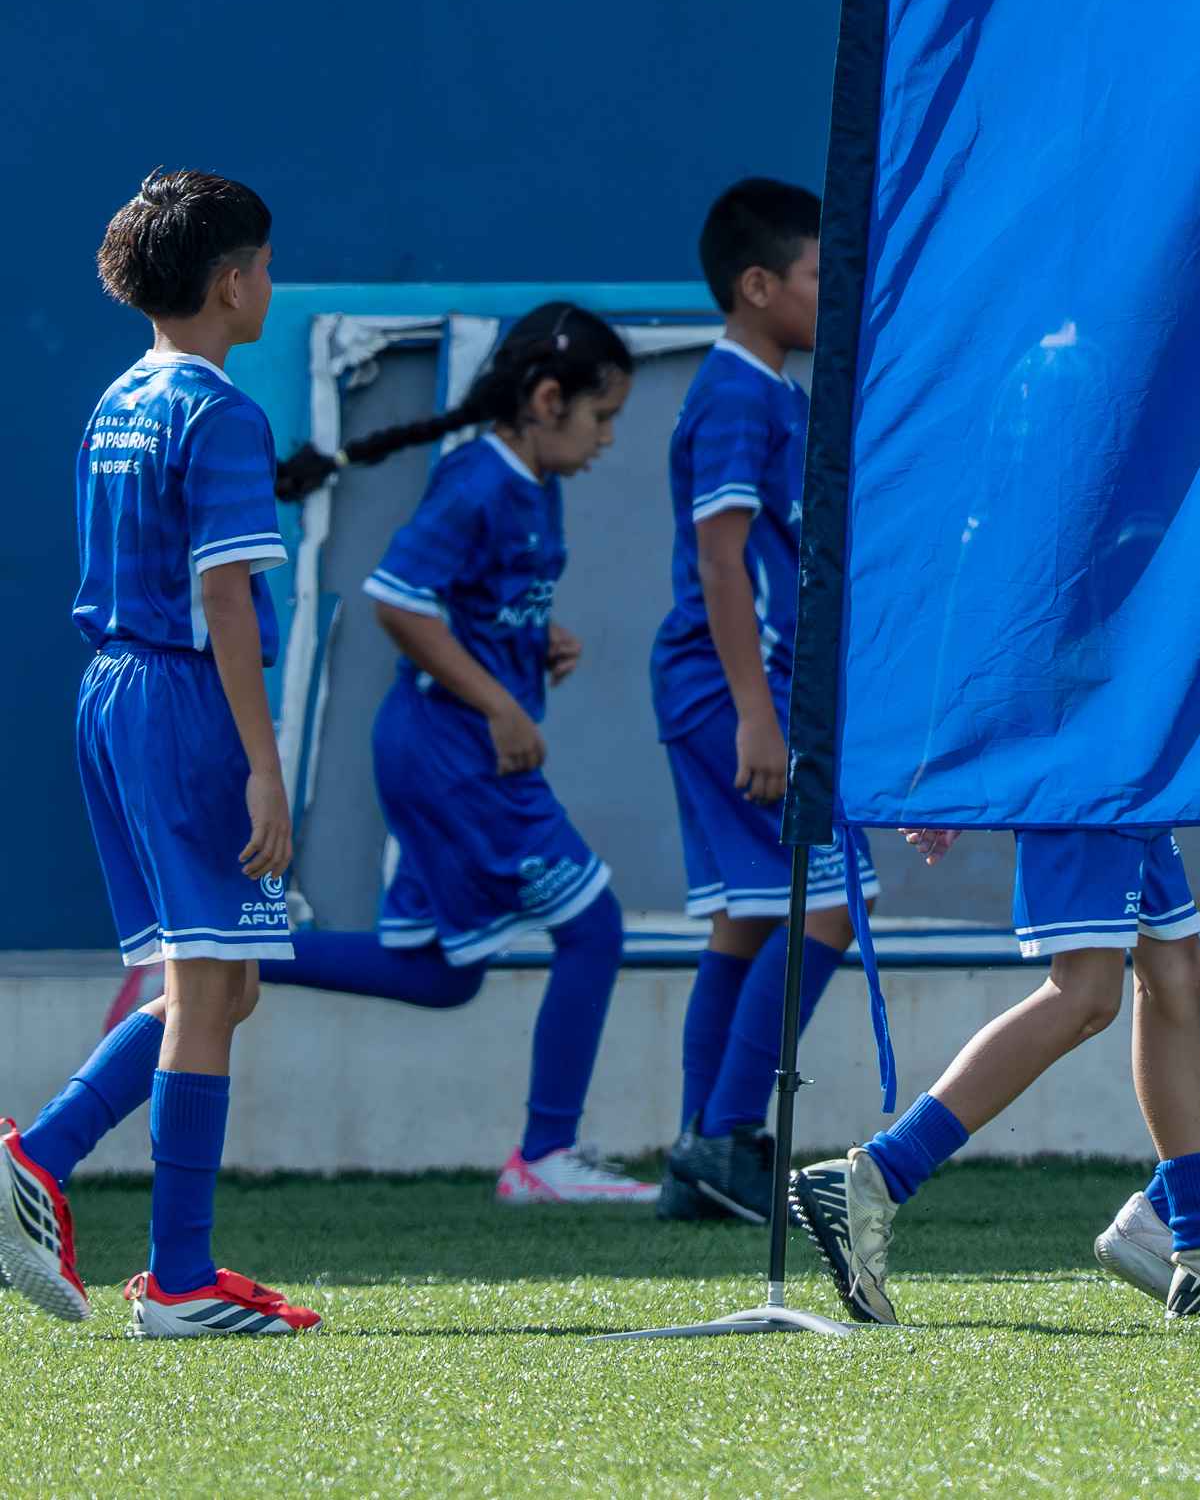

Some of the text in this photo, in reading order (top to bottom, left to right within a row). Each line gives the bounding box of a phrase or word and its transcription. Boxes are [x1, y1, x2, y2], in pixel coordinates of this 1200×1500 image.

[241, 902, 287, 912] CAMP
[238, 913, 288, 925] AFUT
[805, 1169, 853, 1252] NIKE
